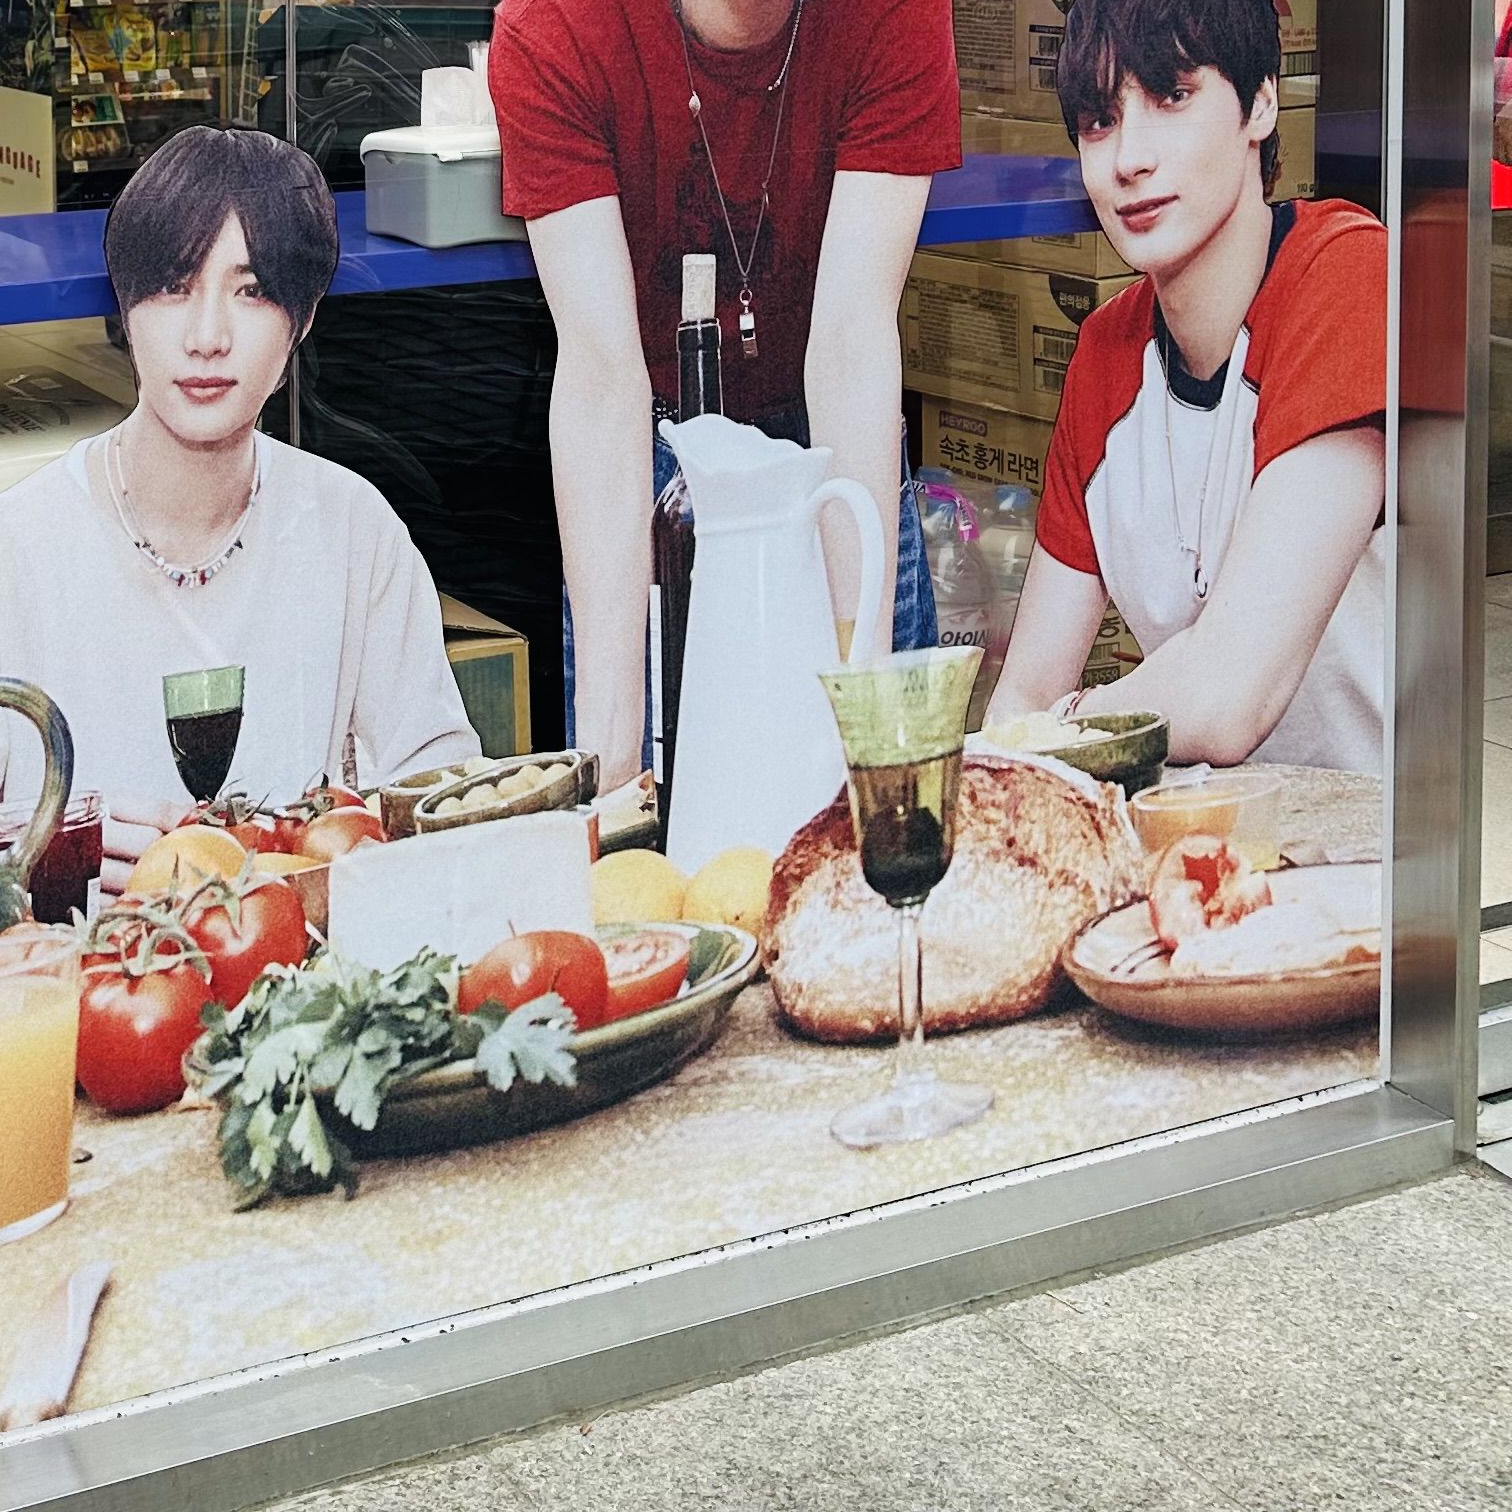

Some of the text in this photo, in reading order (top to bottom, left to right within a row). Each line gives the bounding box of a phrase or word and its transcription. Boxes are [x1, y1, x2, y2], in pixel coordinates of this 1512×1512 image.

[1059, 291, 1091, 312] 편의점용
[940, 413, 986, 435] HEYROO
[939, 435, 970, 463] 속초
[972, 441, 1004, 475] 홍게
[1007, 451, 1040, 485] 라면
